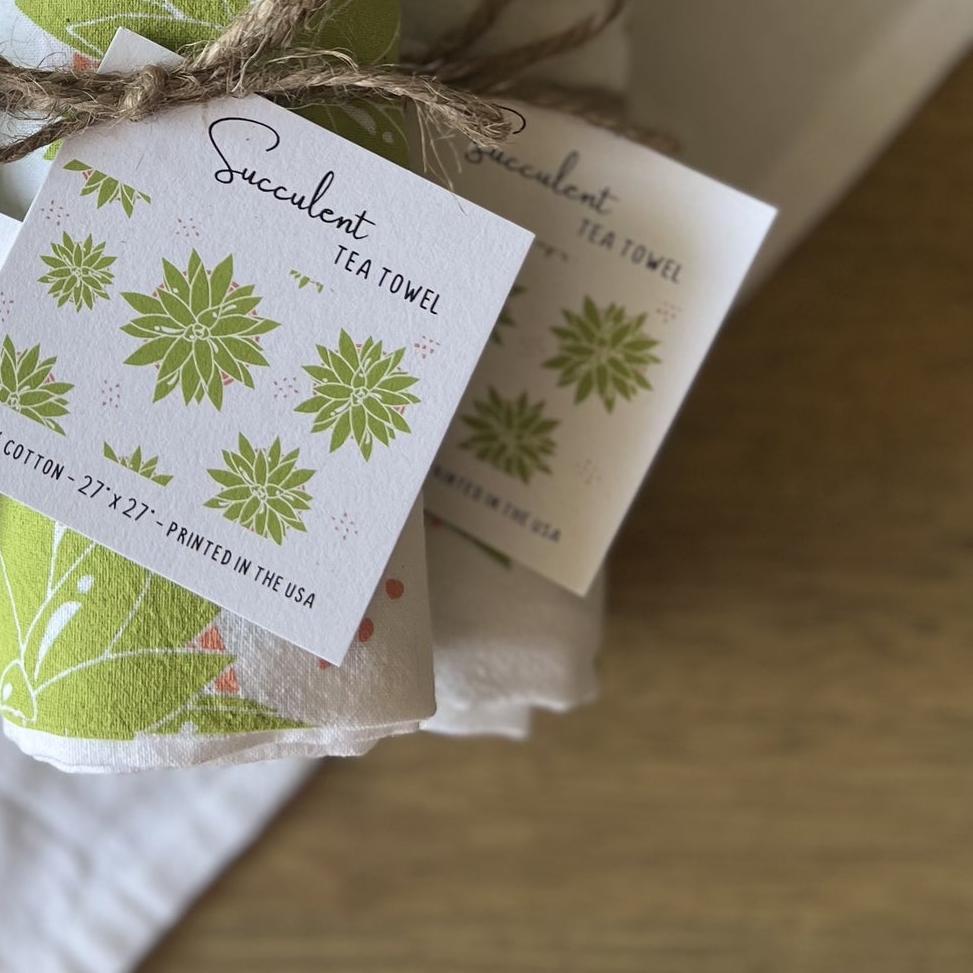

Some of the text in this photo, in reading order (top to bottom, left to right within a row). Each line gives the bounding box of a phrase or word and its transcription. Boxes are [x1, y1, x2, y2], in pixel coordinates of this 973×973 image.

[208, 116, 376, 240] Succulent
[334, 244, 441, 315] TEA TOWEL
[577, 218, 682, 284] TEA TOWEL
[3, 439, 65, 481] COTTON
[166, 521, 233, 566] PRINTED
[233, 555, 253, 576] IN
[254, 565, 284, 593] THE
[285, 581, 316, 609] USA
